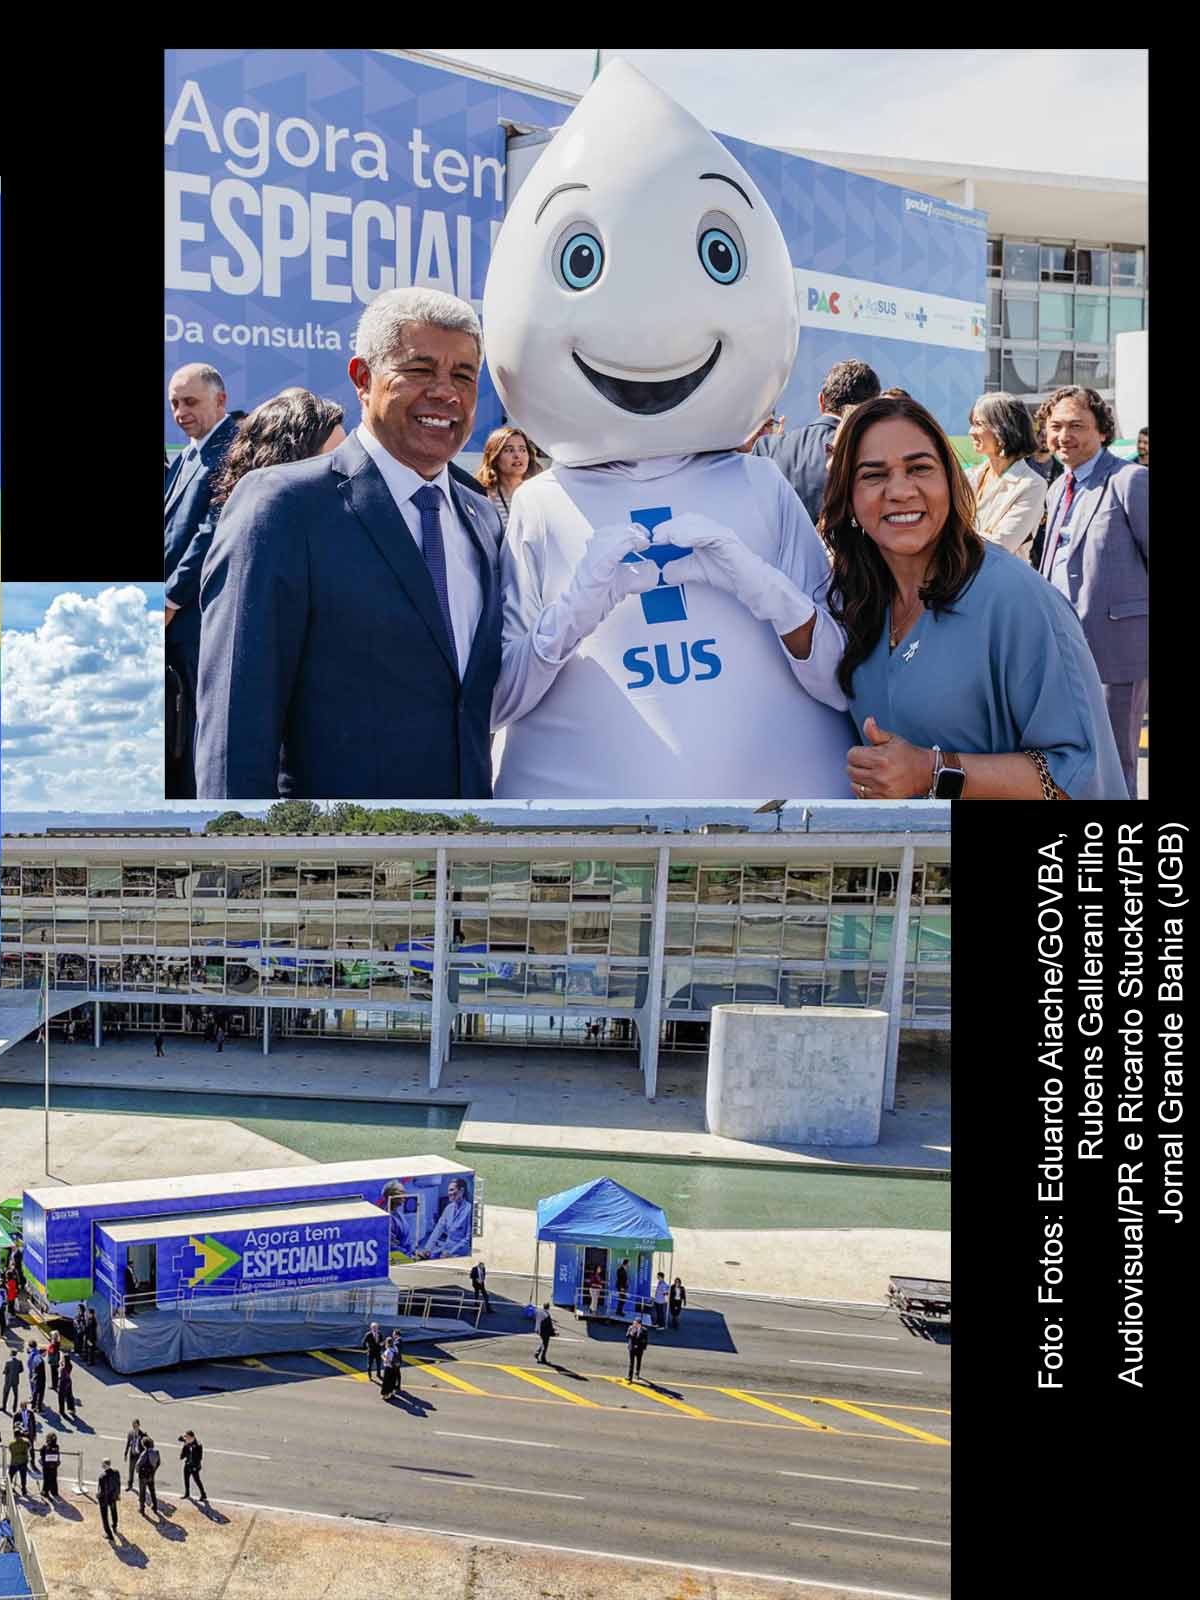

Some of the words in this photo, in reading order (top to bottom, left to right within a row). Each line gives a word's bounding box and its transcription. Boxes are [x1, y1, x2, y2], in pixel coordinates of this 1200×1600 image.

[164, 79, 390, 182] Agora
[808, 287, 841, 314] PAC
[164, 314, 204, 343] Da
[212, 322, 341, 350] consulta
[622, 638, 722, 689] SUS
[244, 1230, 300, 1249] Agora
[305, 1226, 340, 1241] tem
[242, 1239, 378, 1279] ESPECIALISTAS
